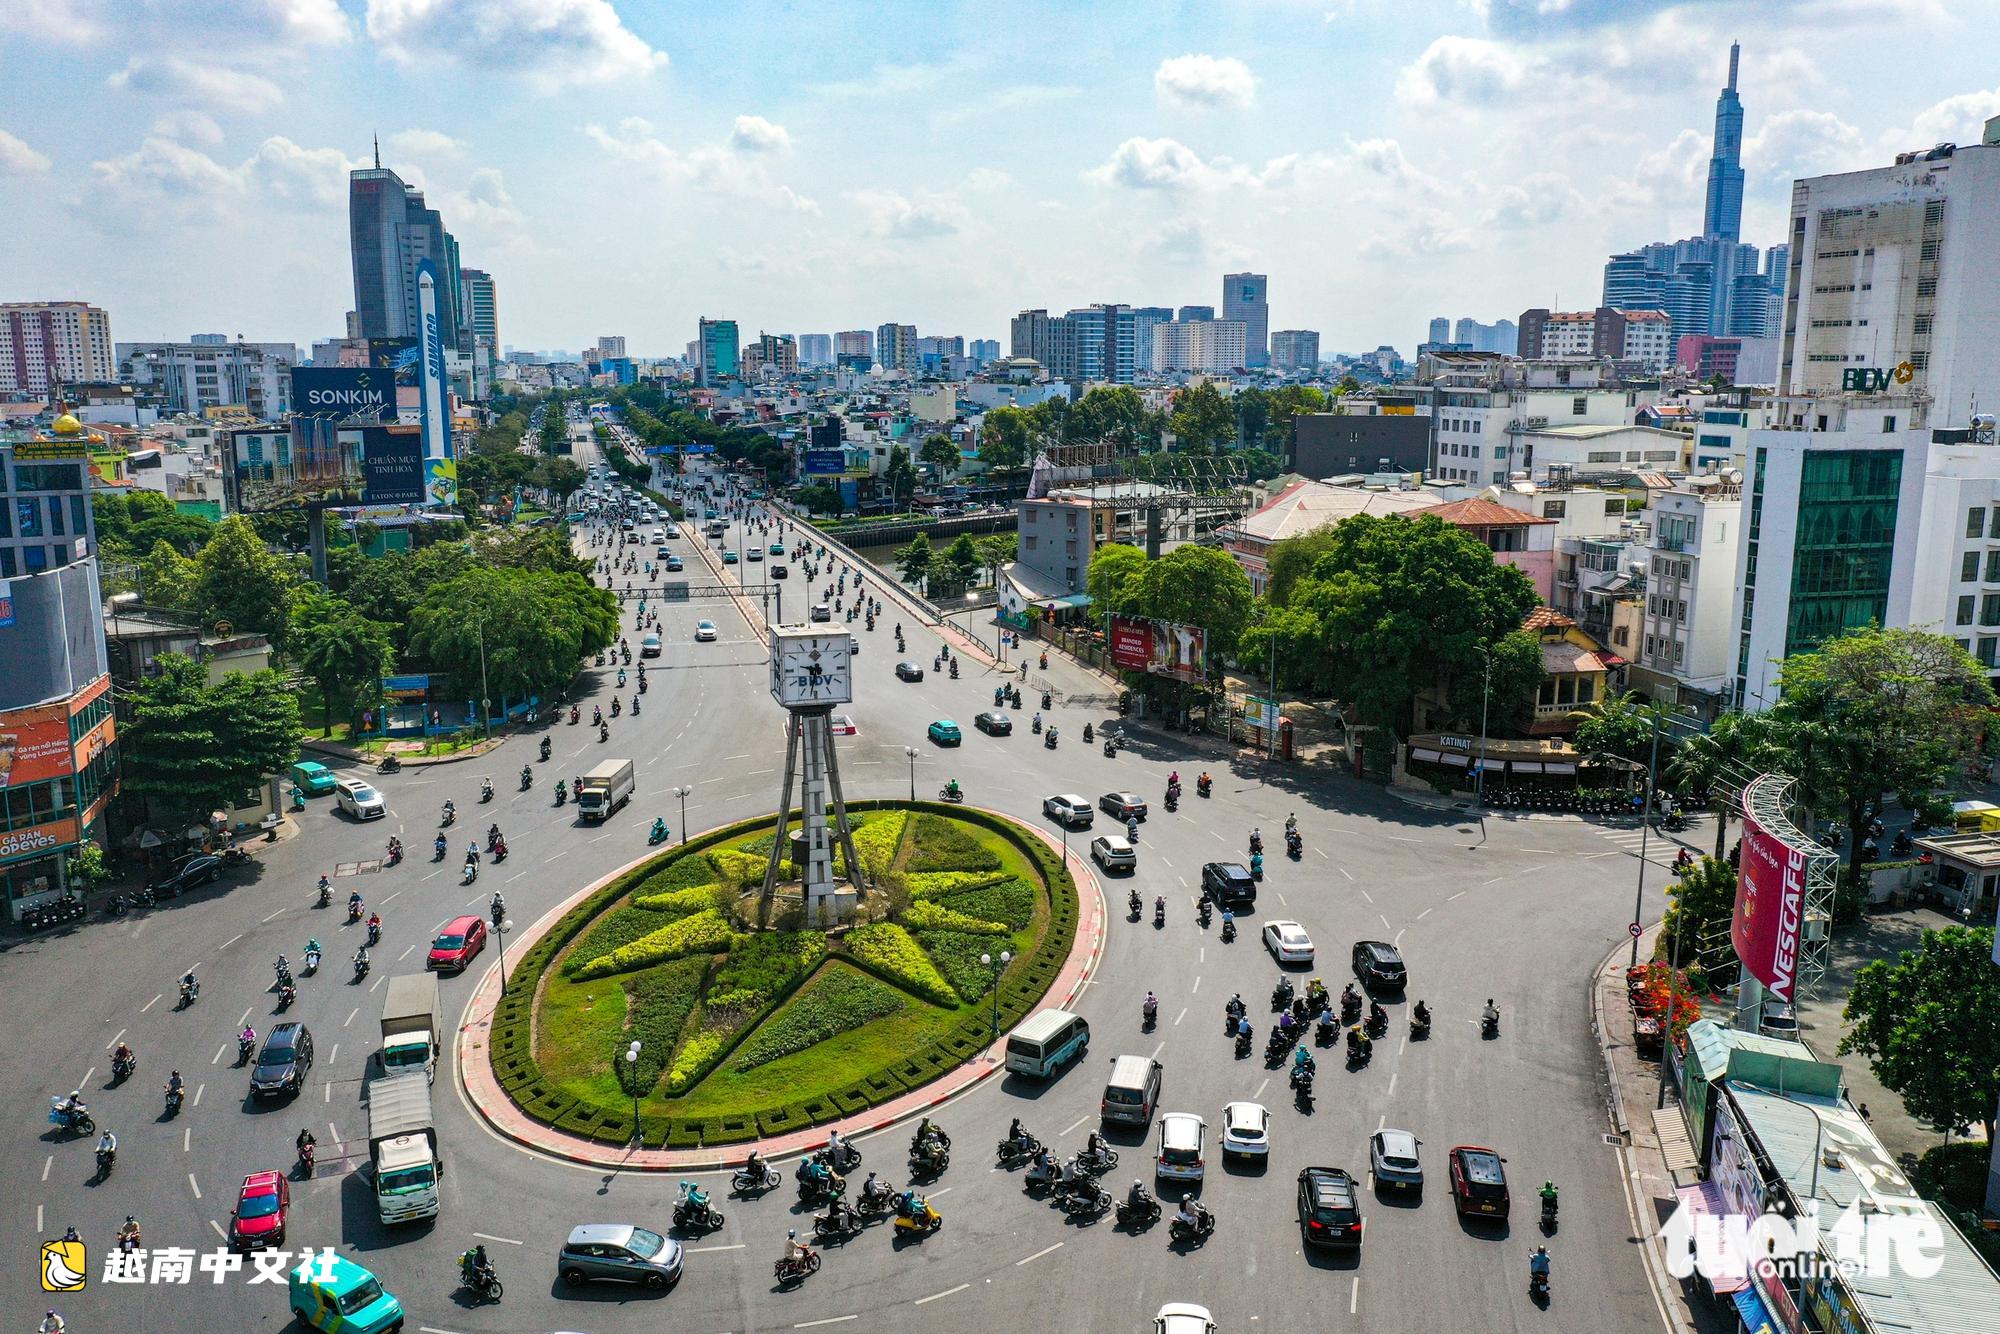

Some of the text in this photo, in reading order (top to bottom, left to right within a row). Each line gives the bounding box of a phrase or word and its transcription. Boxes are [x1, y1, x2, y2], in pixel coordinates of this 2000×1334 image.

[426, 313, 439, 380] SAWACO
[1842, 367, 1896, 391] BIDV
[308, 389, 383, 404] SONKIM
[371, 491, 420, 501] EATON PARK
[1121, 637, 1142, 646] BRANDED
[1118, 644, 1145, 654] RESIDENCES
[798, 674, 833, 687] BIDV
[1440, 735, 1472, 750] KATINAT
[38, 747, 69, 757] Louisiana
